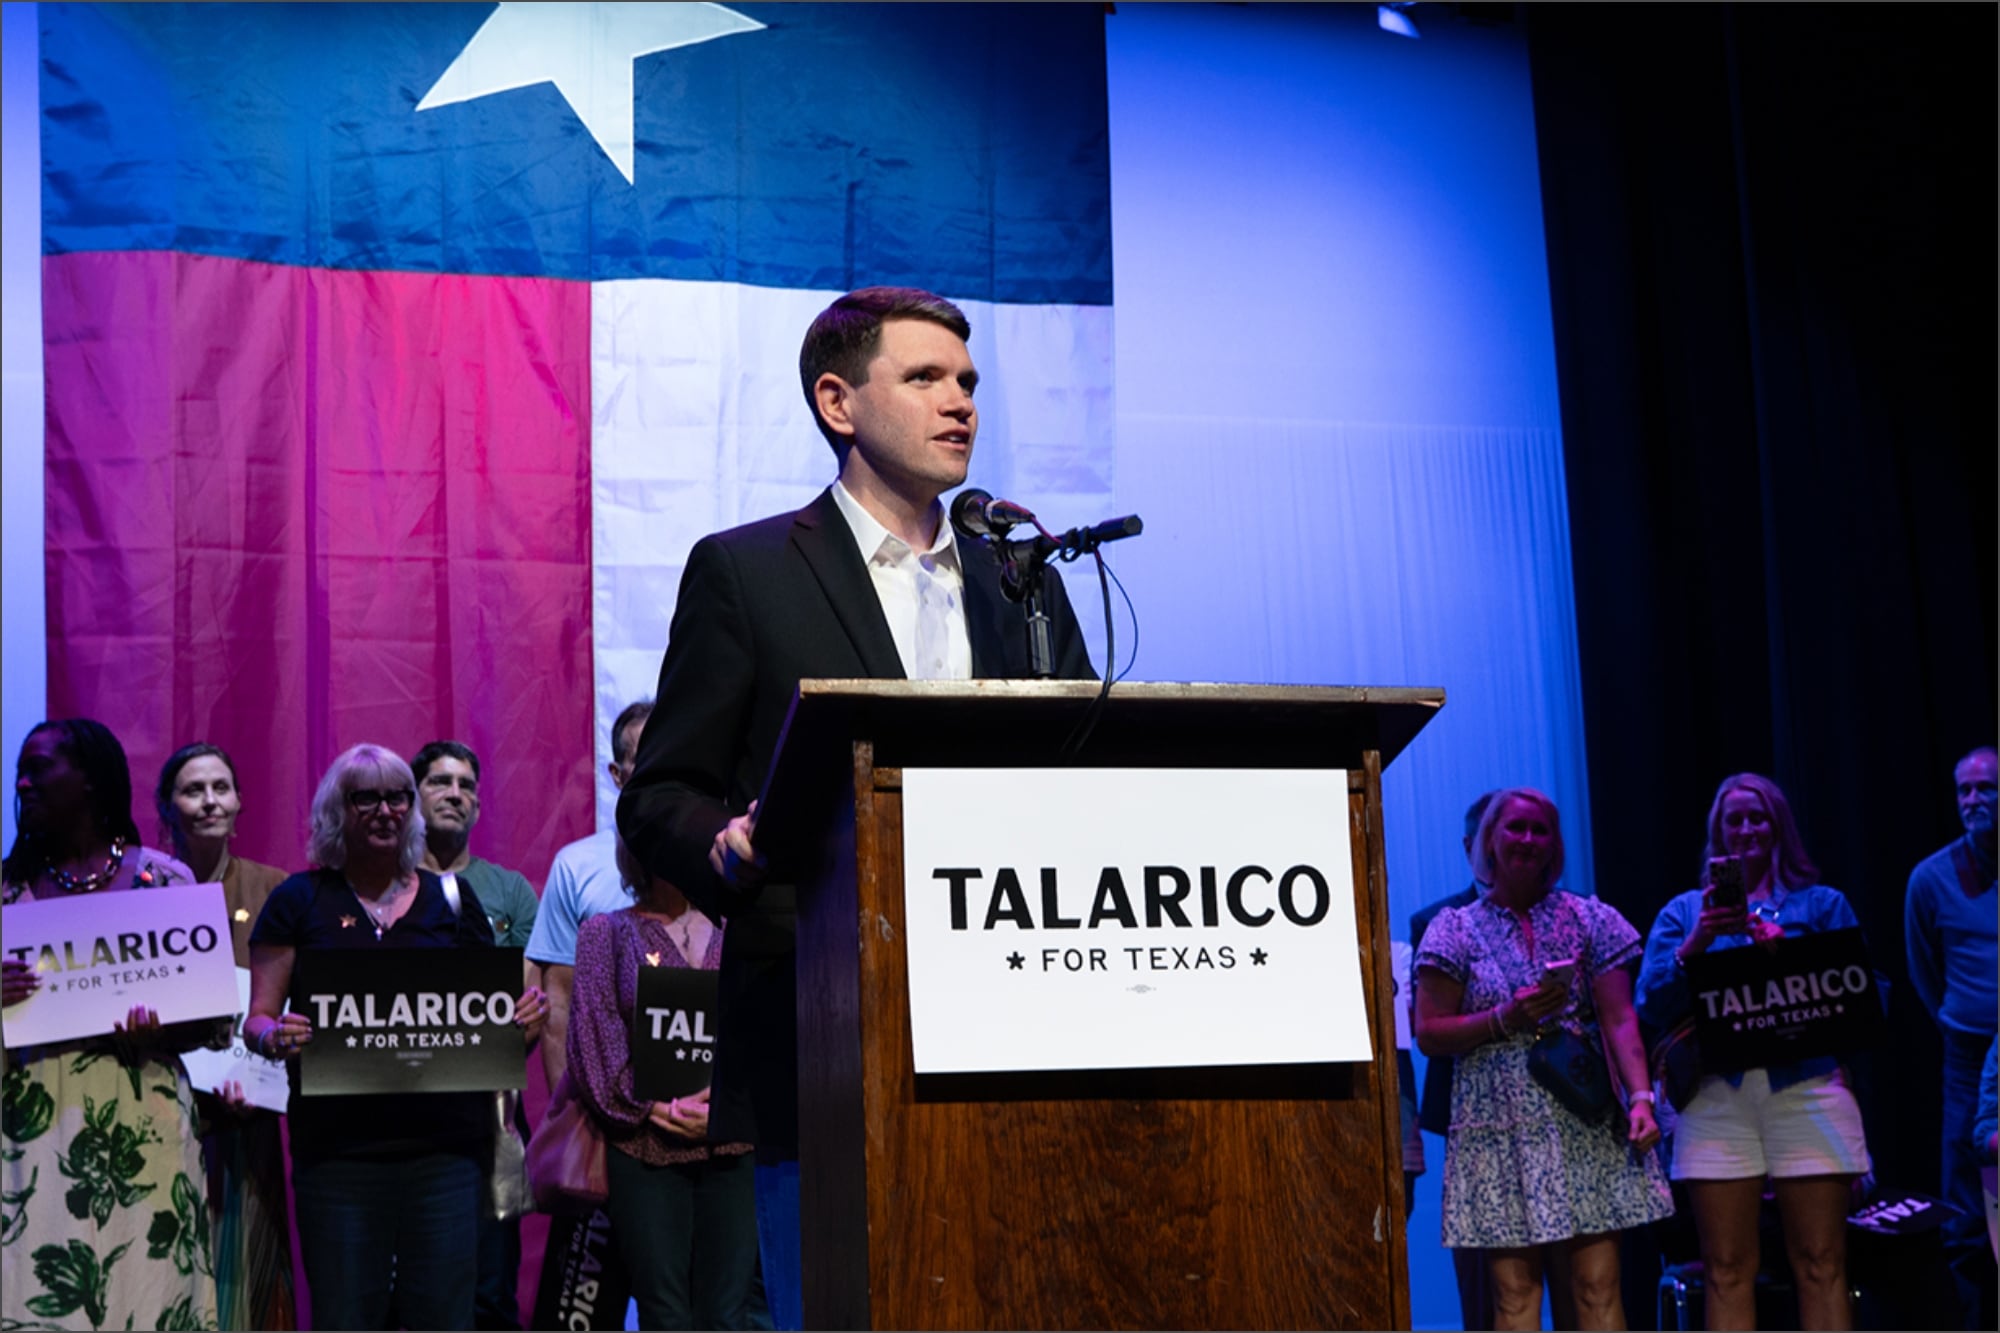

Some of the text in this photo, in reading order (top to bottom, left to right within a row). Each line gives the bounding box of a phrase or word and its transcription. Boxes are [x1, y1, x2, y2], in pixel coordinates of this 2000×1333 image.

[932, 864, 1331, 931] TALARICO
[9, 925, 218, 973] TALARICO
[1042, 946, 1237, 972] FOR TEXAS
[67, 965, 170, 991] FOR TEXAS
[1699, 965, 1868, 1019] TALARICO
[310, 991, 516, 1028] TALARICO
[645, 1007, 717, 1043] TAL
[1747, 1004, 1831, 1030] FOR TEXAS
[223, 1046, 253, 1061] OR
[363, 1032, 465, 1048] FOR TEXAS
[1861, 1198, 1931, 1225] TAL
[568, 1208, 611, 1332] ALARIC
